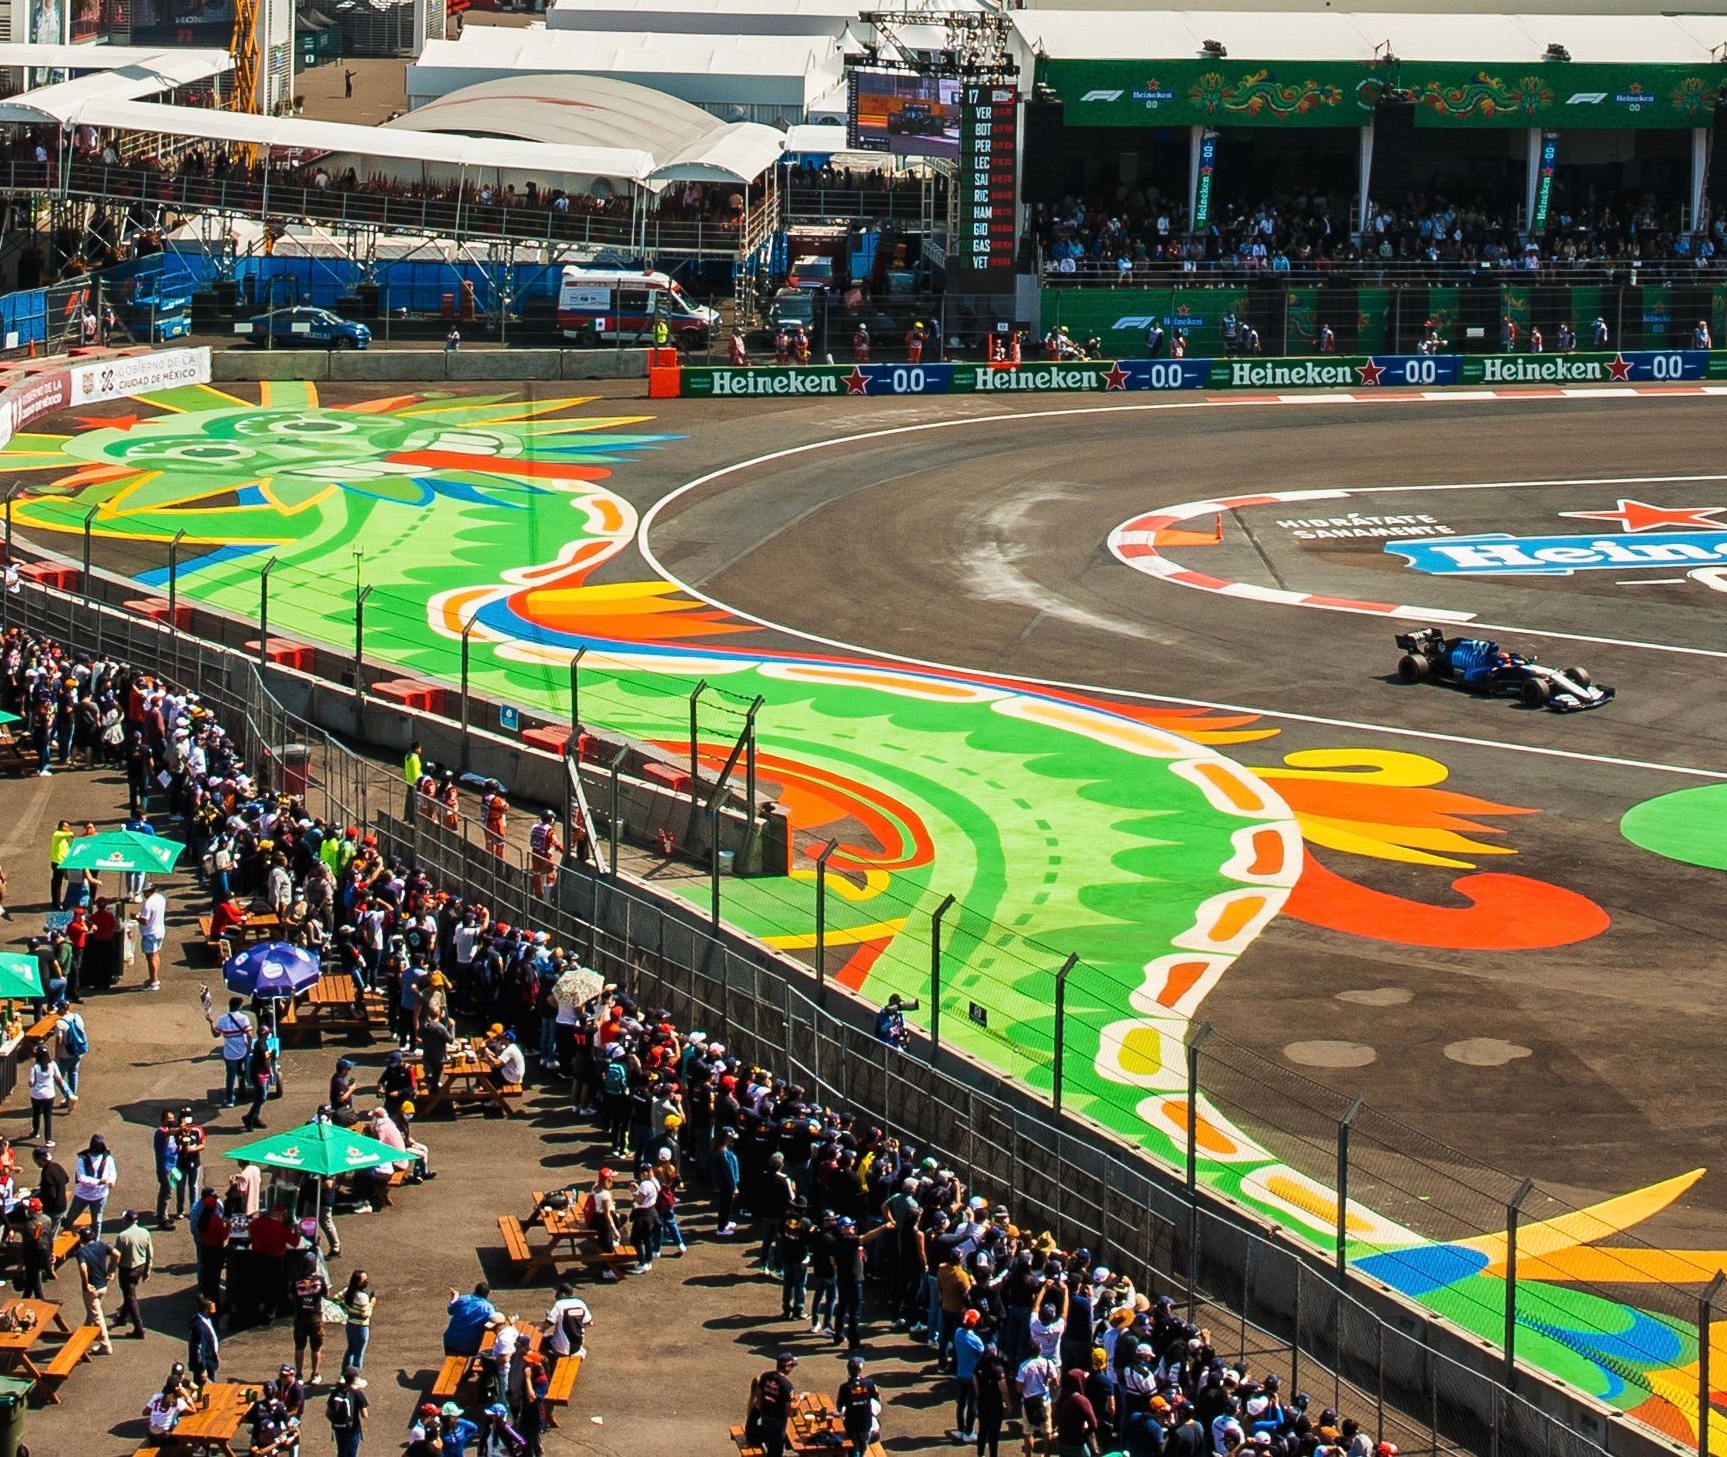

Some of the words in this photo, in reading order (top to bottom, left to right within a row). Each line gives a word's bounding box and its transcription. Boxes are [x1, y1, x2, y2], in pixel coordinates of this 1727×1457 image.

[968, 89, 979, 104] 17
[975, 106, 992, 119] VER
[974, 123, 992, 136] BOT
[974, 139, 991, 153] PER
[974, 156, 990, 169] LEC
[974, 173, 988, 186] SAI
[974, 189, 988, 203] RIC
[1197, 175, 1210, 221] Heineken
[1537, 176, 1551, 222] Heineken
[973, 206, 992, 219] HAM
[973, 222, 988, 236] GIO
[973, 239, 991, 252] GAS
[973, 255, 989, 269] VET
[1163, 315, 1203, 326] Hineken
[118, 360, 165, 377] GOBIERNO
[167, 357, 179, 368] DE
[182, 355, 196, 366] LA
[1484, 358, 1602, 381] Heineken
[118, 376, 149, 390] CIUDAD
[151, 374, 161, 384] DE
[162, 367, 196, 381] MÉXICO
[975, 366, 1098, 390] Heineken
[1232, 362, 1353, 386] Heineken
[712, 371, 838, 394] Heineken
[1276, 512, 1438, 529] HIDRÁTATE
[1293, 525, 1457, 540] SANAMENTE
